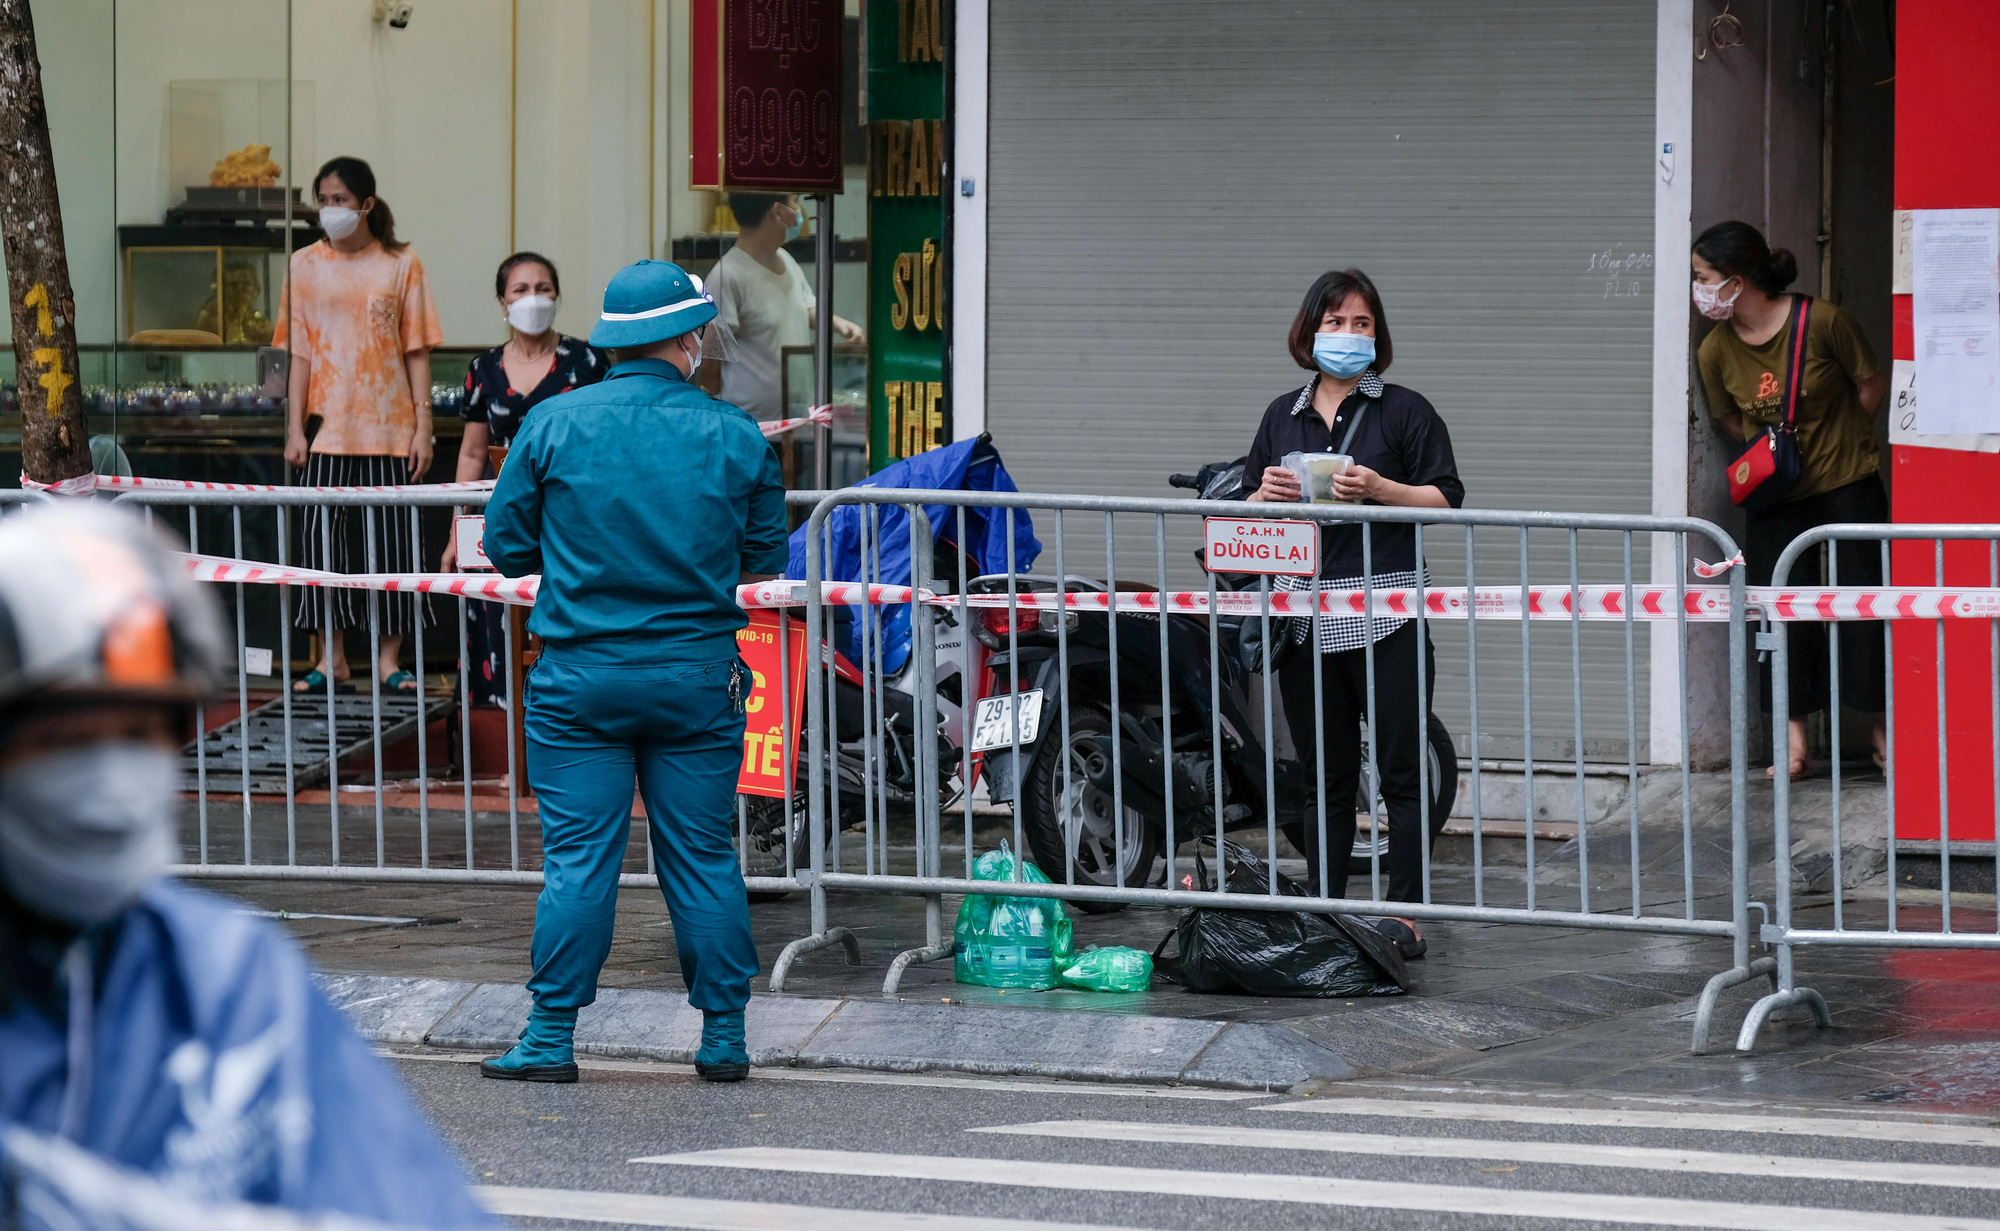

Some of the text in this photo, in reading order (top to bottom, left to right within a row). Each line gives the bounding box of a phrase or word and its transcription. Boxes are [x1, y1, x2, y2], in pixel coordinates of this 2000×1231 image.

[733, 86, 834, 167] 9999
[1236, 525, 1285, 537] C.A.H.N
[1213, 537, 1308, 565] DỪNG LẠI
[984, 694, 1032, 723] 29-2
[976, 717, 1034, 748] 521.5
